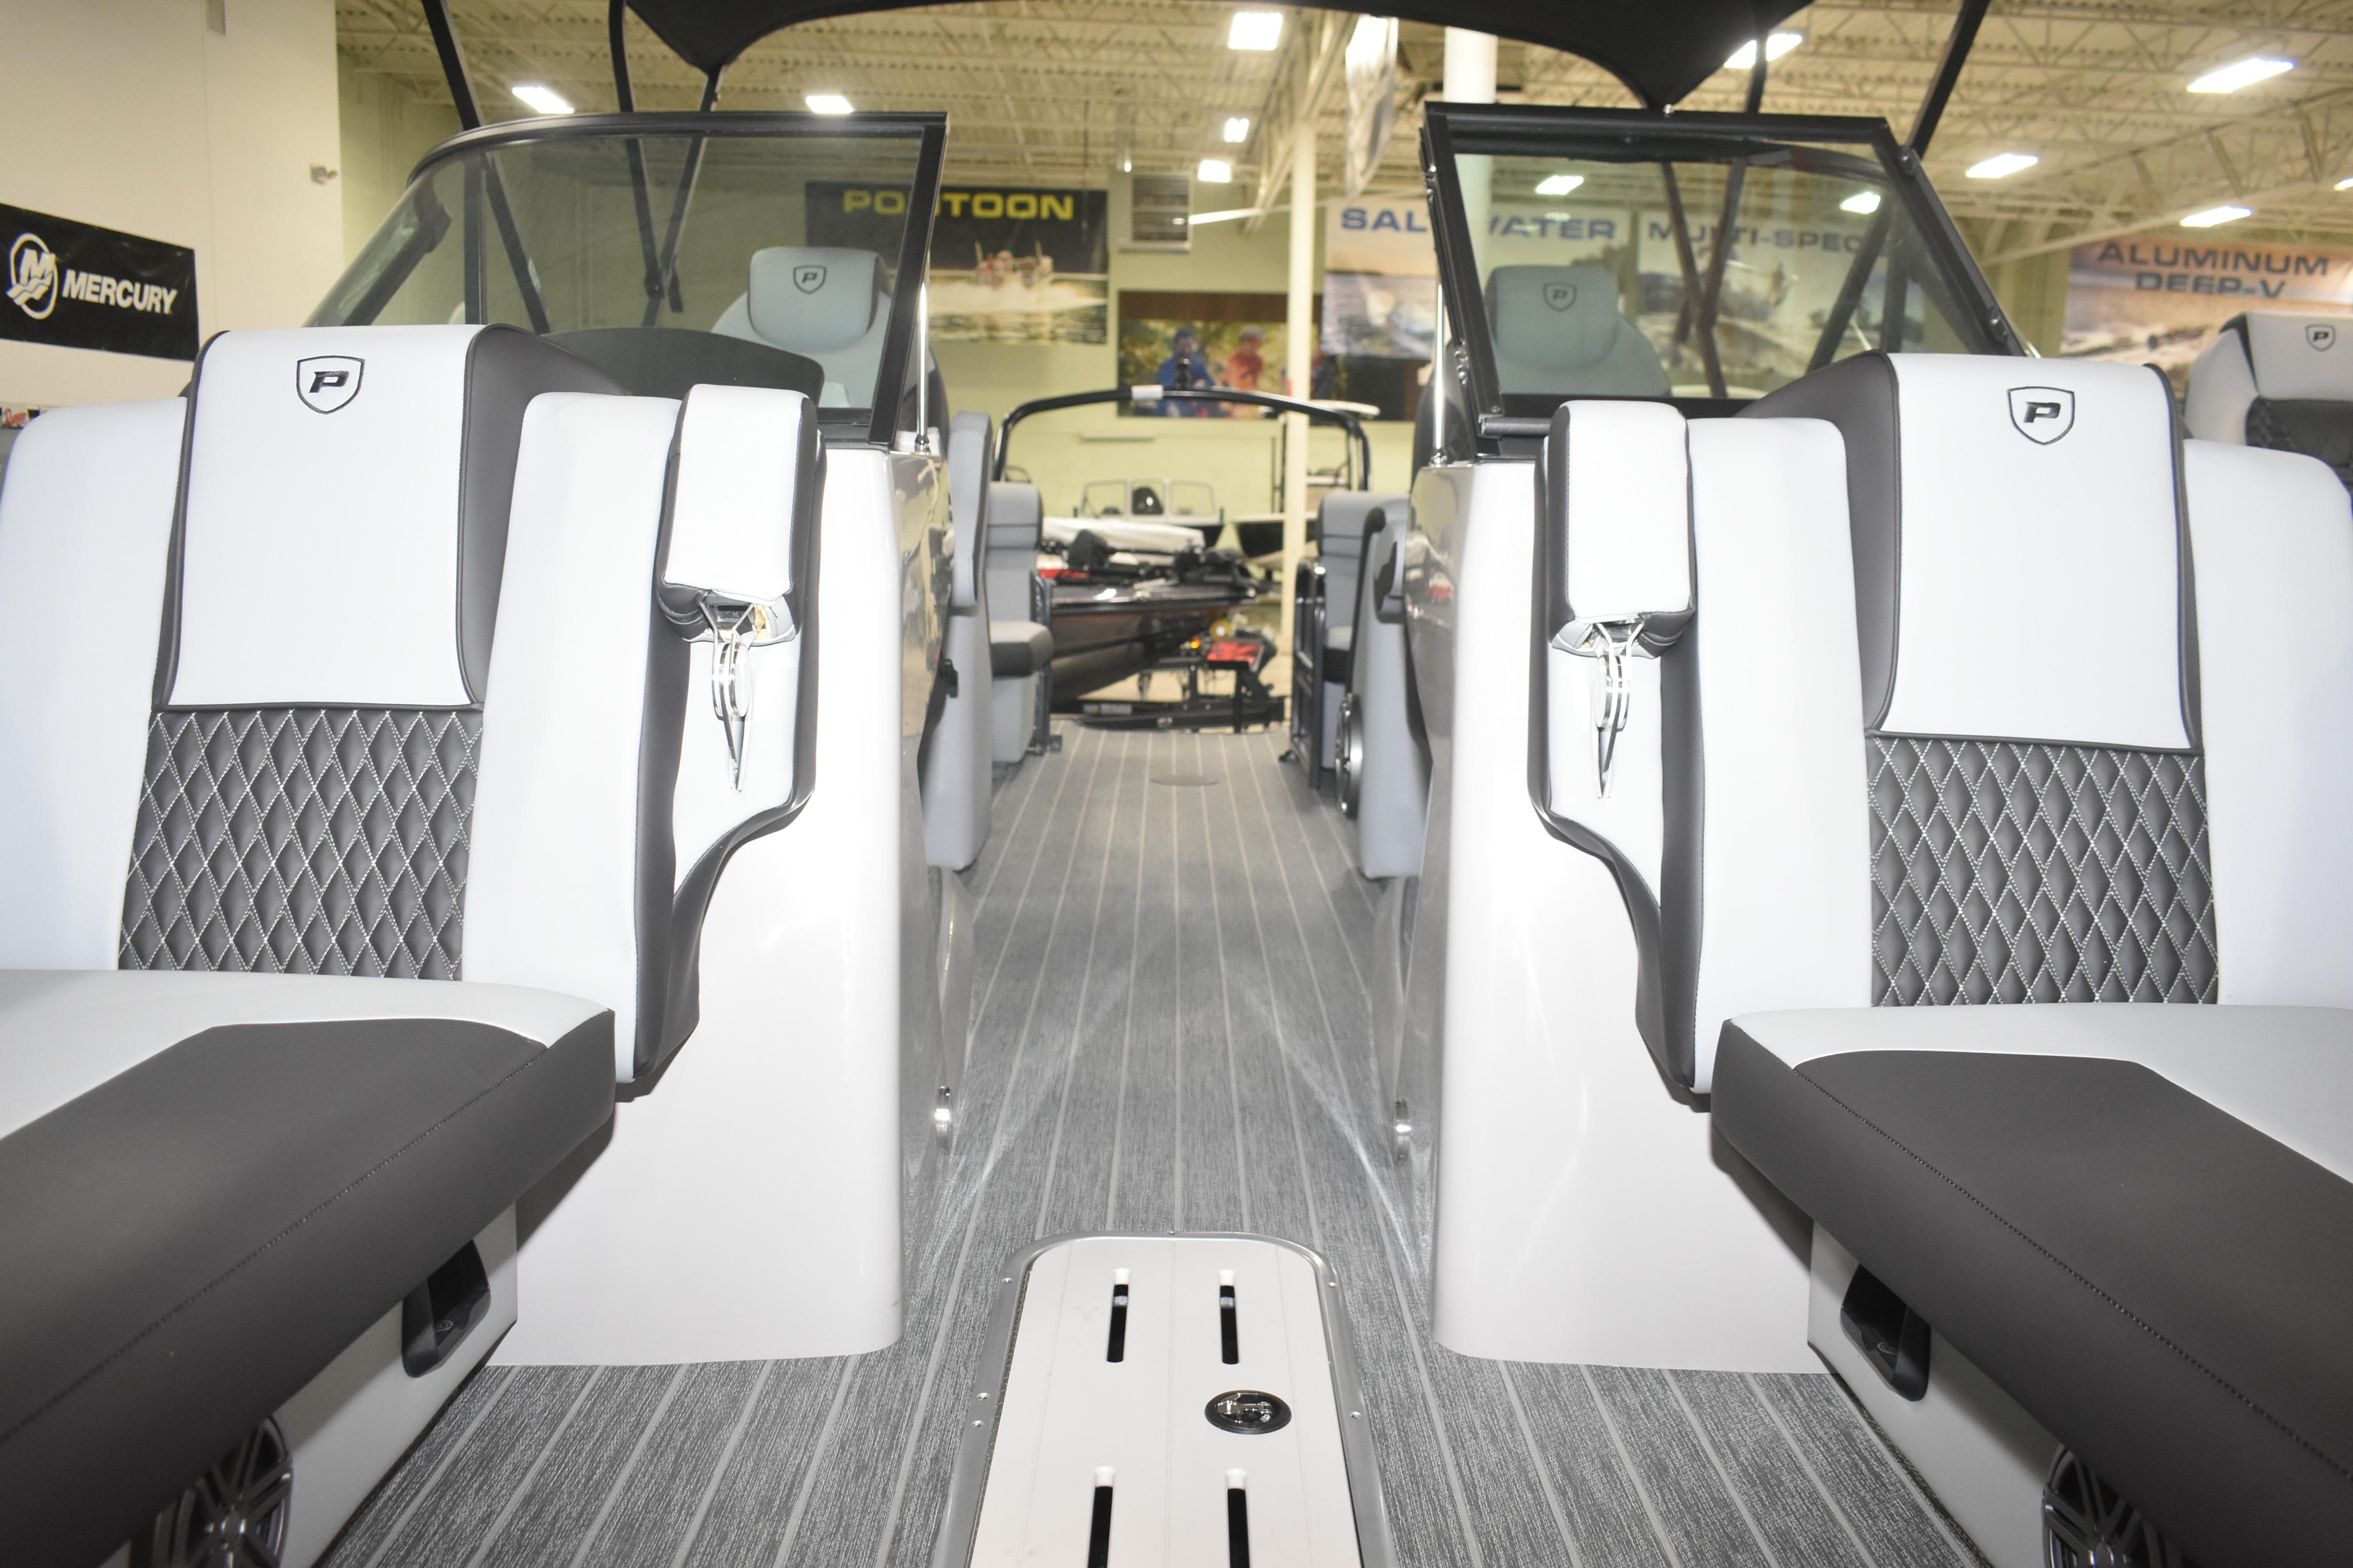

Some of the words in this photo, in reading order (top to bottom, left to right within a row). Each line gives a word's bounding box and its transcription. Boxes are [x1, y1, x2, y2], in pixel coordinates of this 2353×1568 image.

[843, 189, 1074, 220] POTOON
[1341, 207, 1616, 240] SALATER
[2098, 243, 2328, 276] ALUMINUM
[802, 272, 817, 283] P
[2136, 272, 2286, 299] DEEP-V
[62, 268, 178, 315] MERCURY
[1553, 289, 1567, 301] P
[2313, 330, 2329, 342] P
[309, 370, 350, 393] P
[2023, 401, 2061, 423] P
